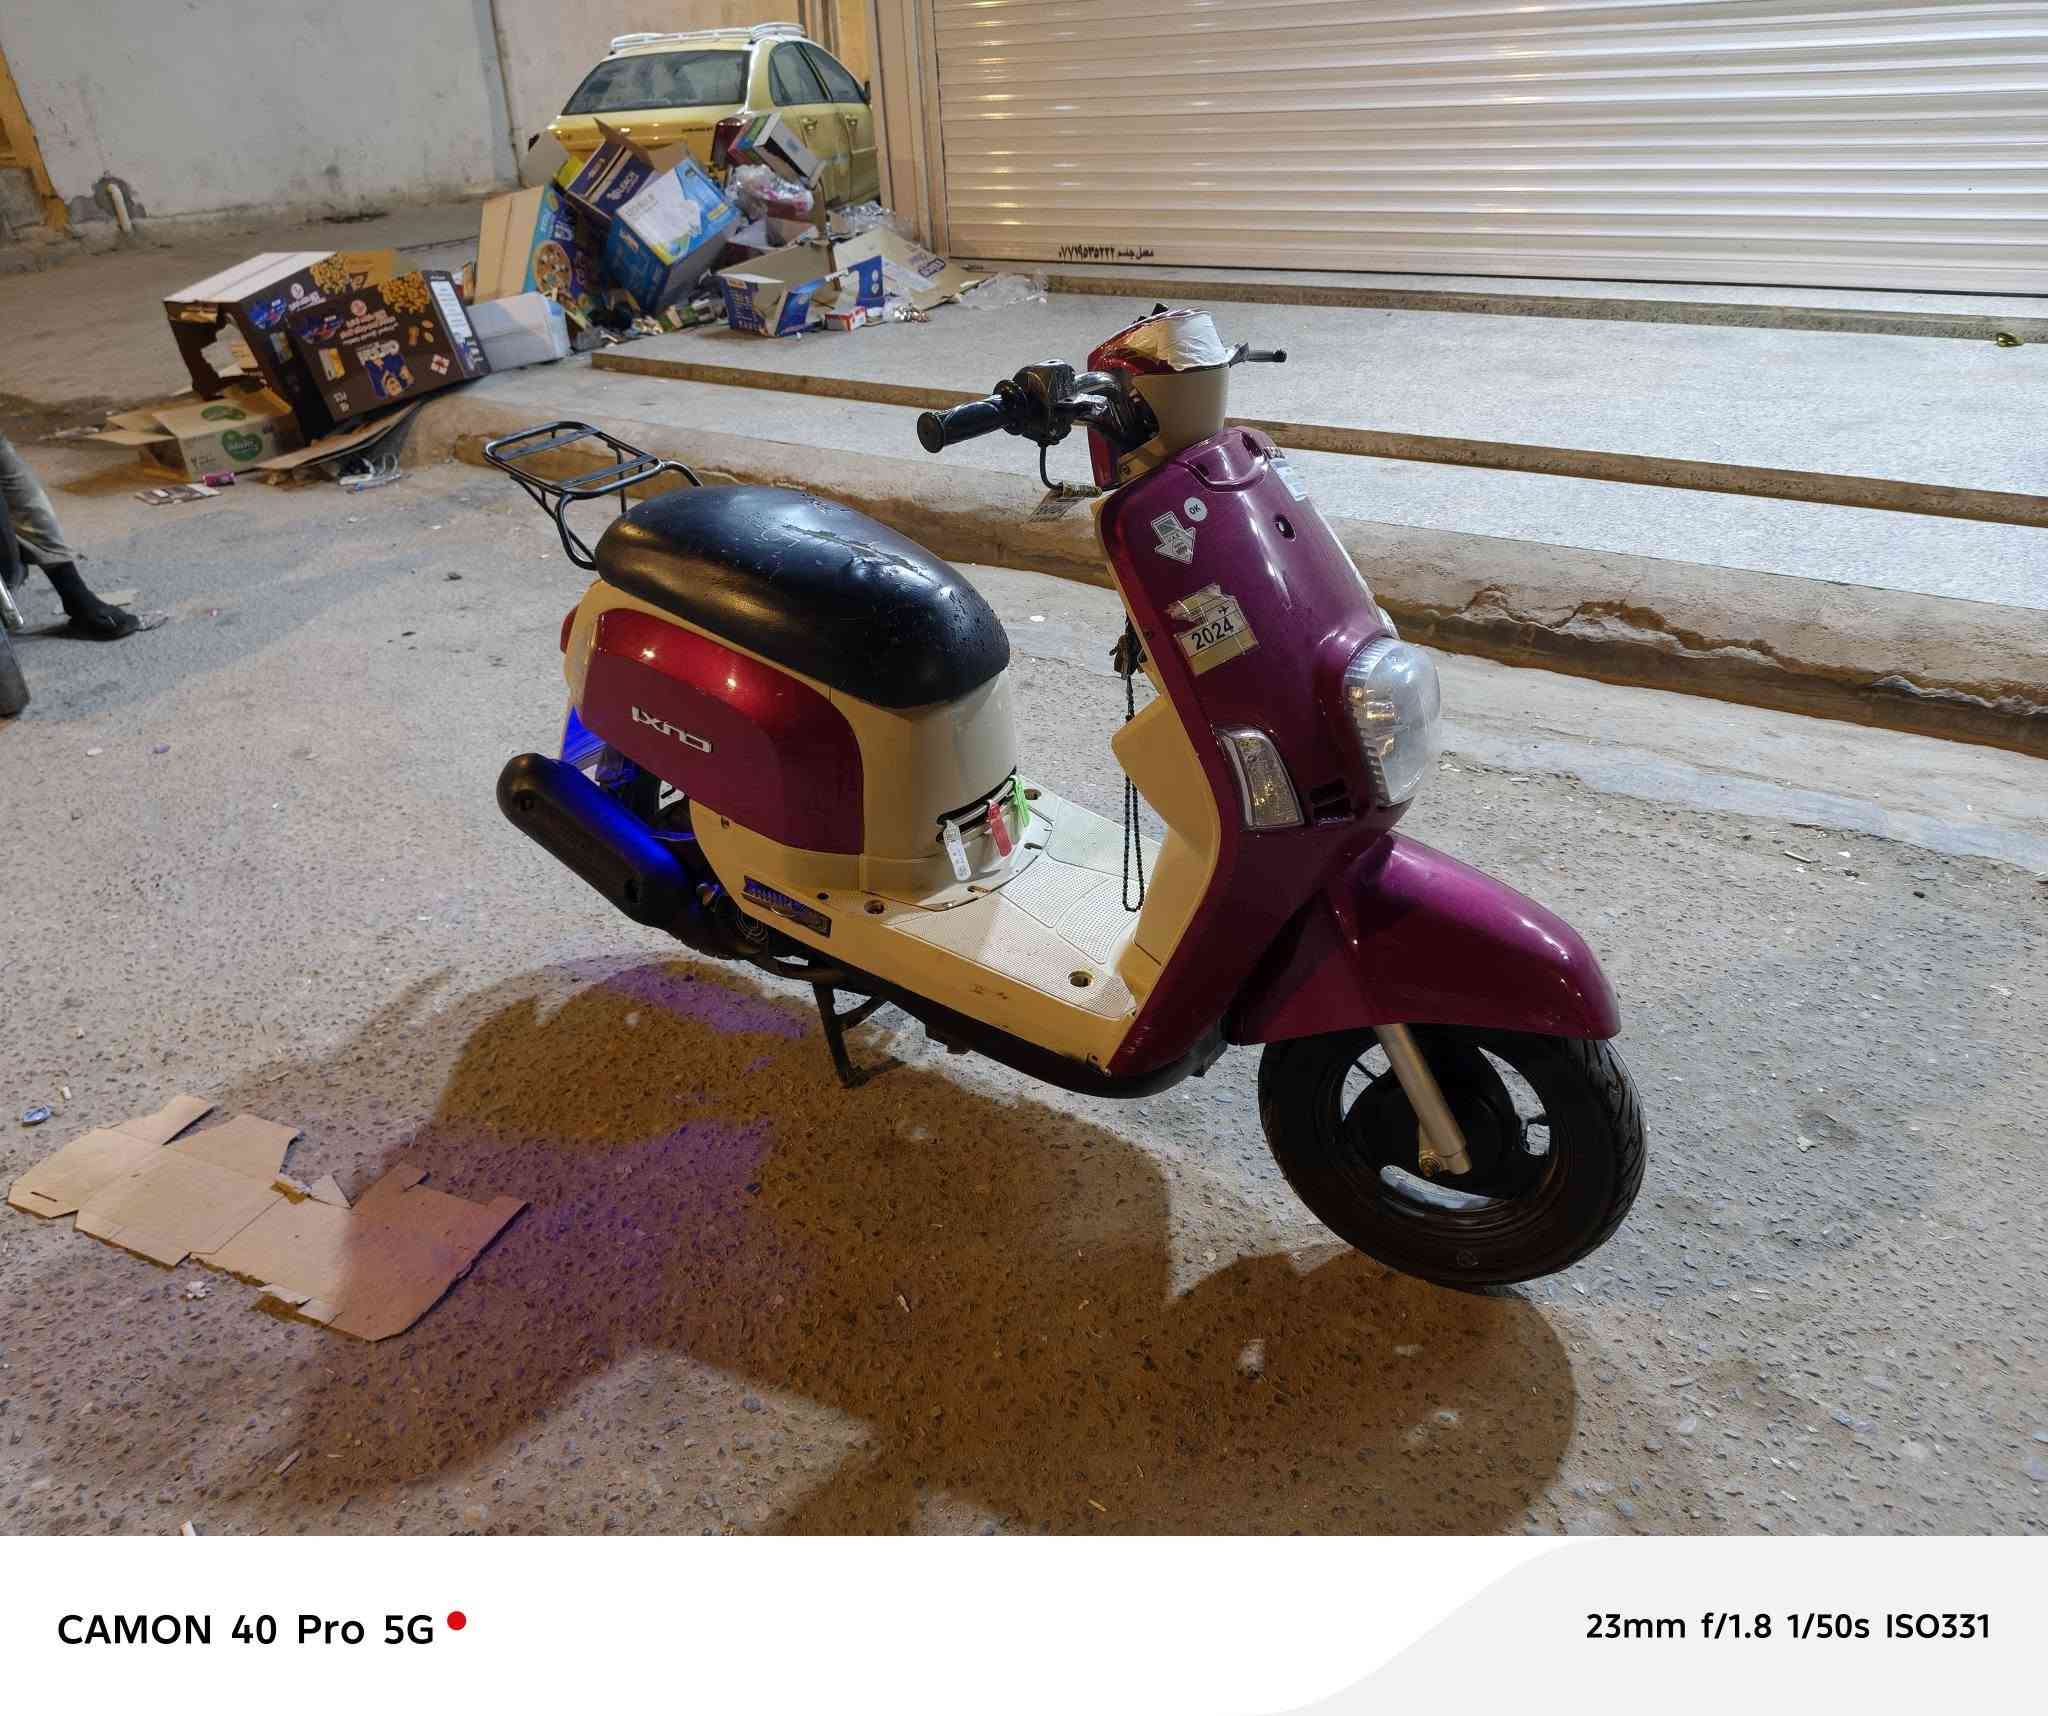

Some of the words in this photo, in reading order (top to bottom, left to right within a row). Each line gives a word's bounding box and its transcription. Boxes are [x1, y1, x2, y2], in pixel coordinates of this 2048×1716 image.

[1189, 503, 1202, 515] OK
[1191, 616, 1235, 651] 2024
[631, 705, 713, 753] CUXI
